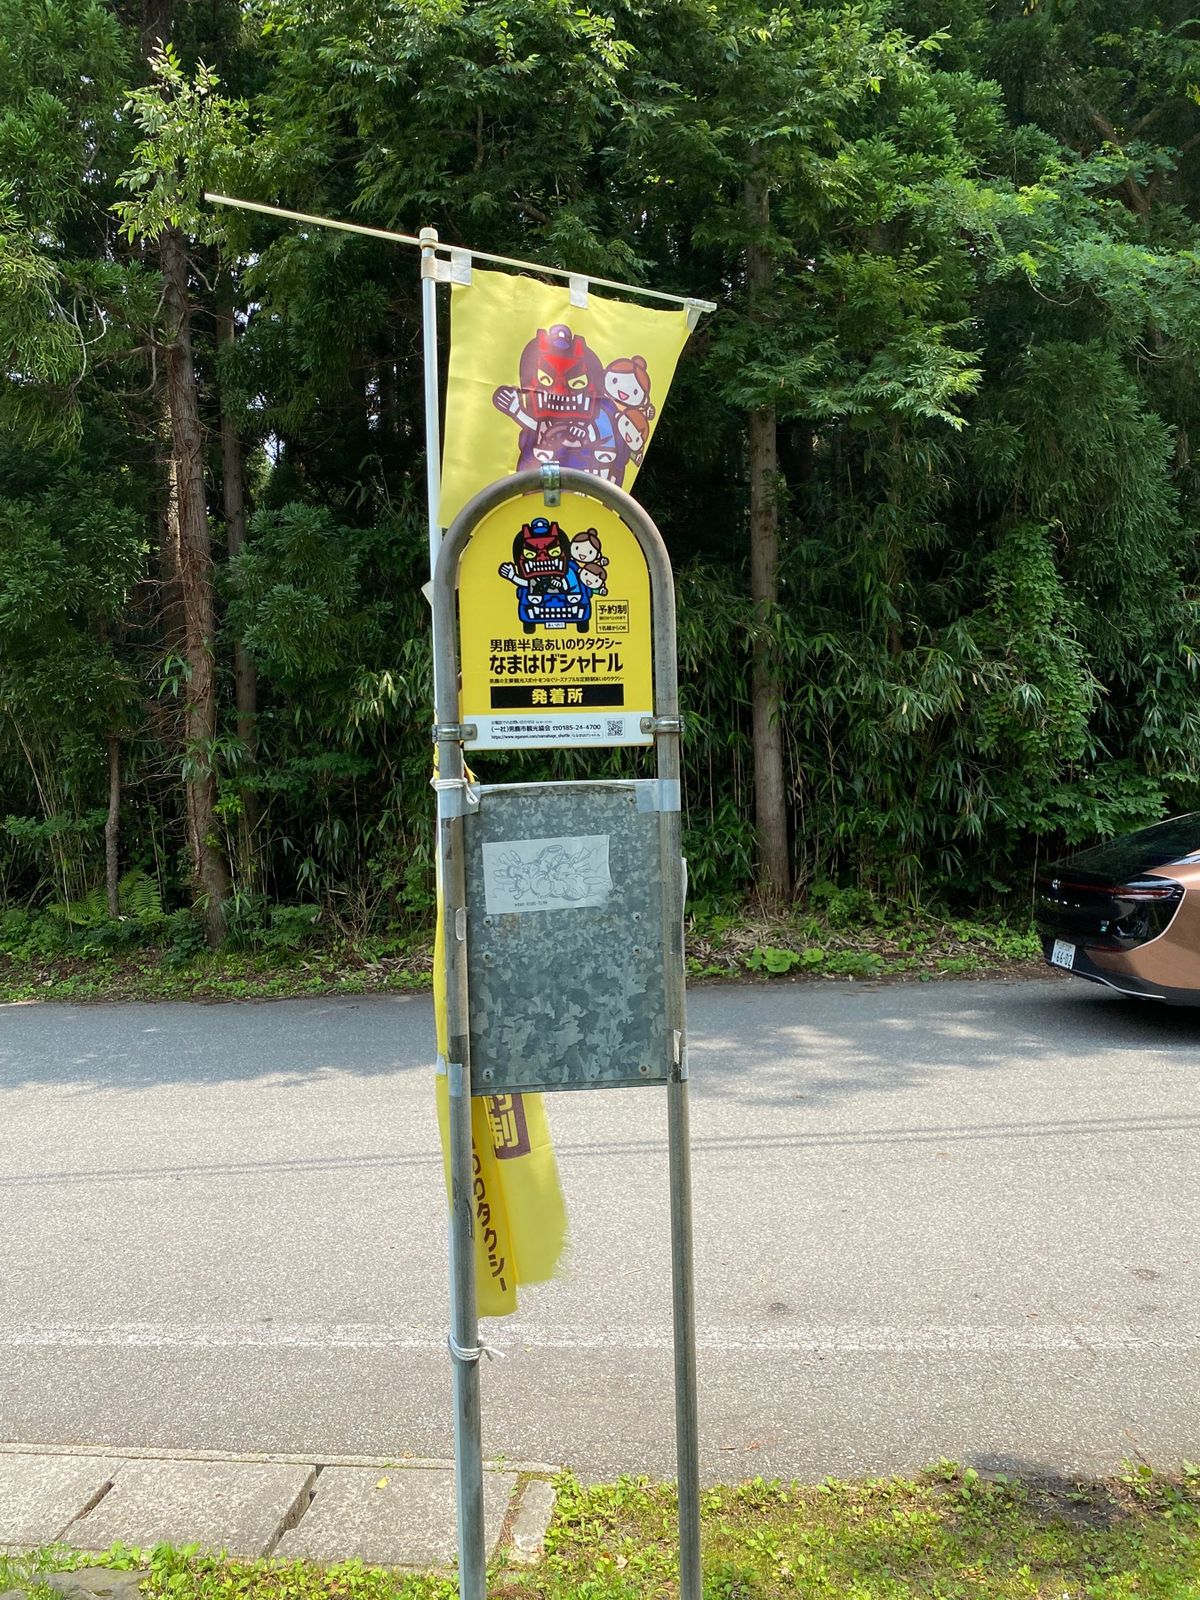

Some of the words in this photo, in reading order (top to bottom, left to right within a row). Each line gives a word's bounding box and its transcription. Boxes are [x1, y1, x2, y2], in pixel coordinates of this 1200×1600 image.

[598, 605, 627, 615] 予約制
[490, 638, 622, 652] 男鹿半島あいのりタクシー
[489, 653, 623, 675] なまはげシャトル
[531, 688, 583, 704] 発着所
